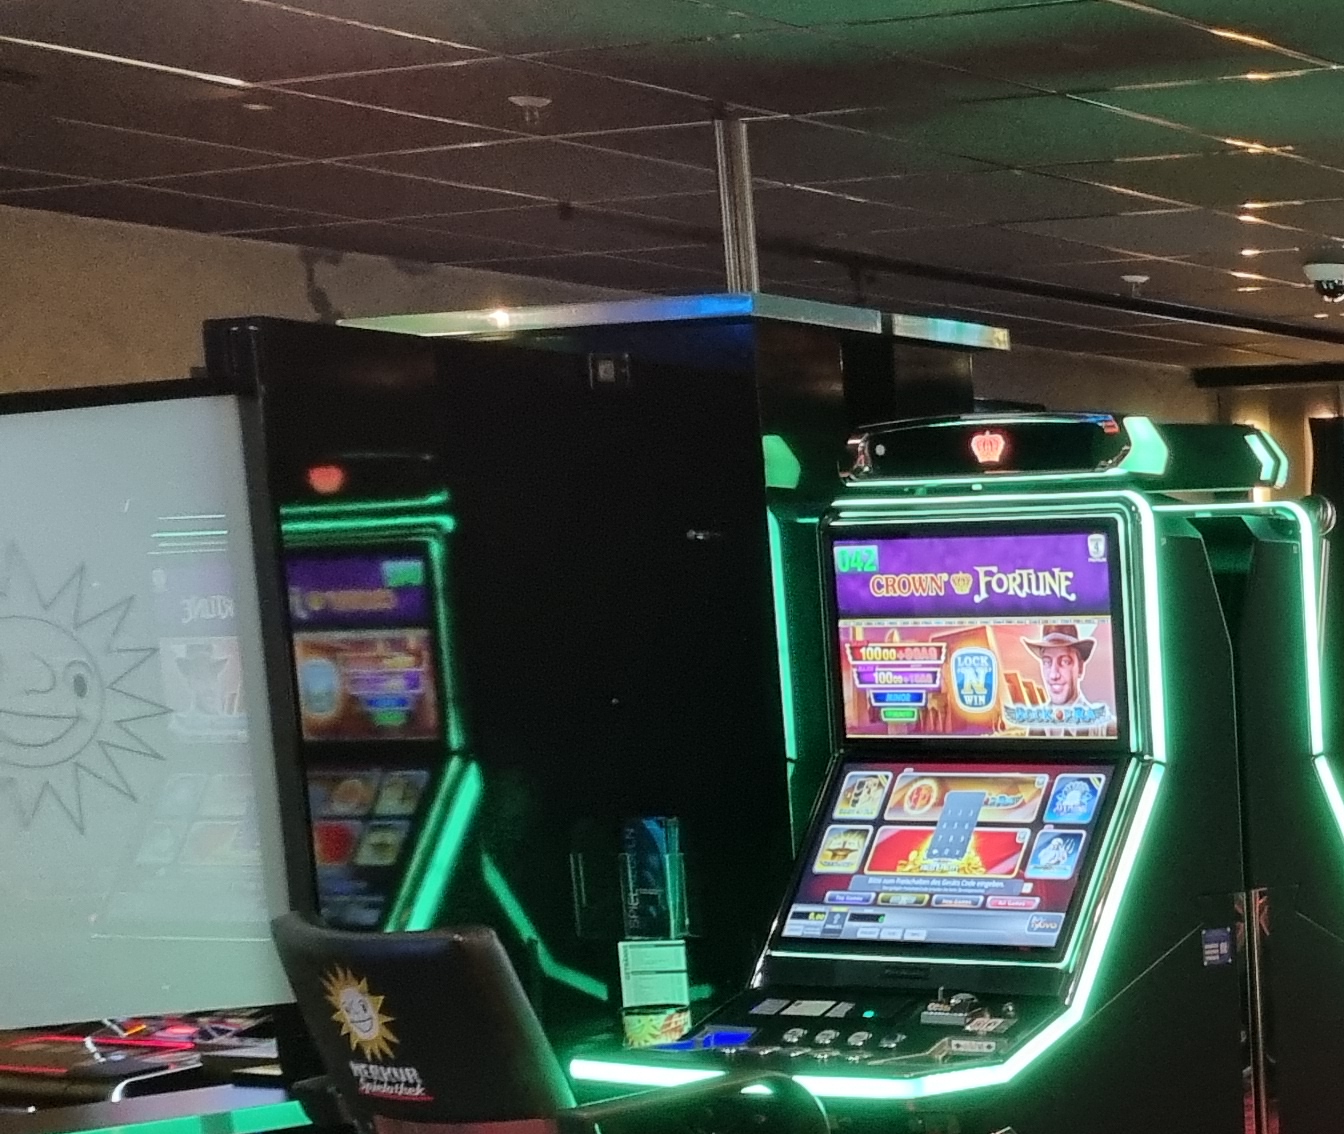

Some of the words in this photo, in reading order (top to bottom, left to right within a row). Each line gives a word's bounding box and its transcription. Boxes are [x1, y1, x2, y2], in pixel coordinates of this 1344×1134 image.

[838, 547, 877, 572] 042
[869, 572, 948, 598] CROWN
[973, 565, 1076, 604] FORTUNE
[957, 656, 989, 667] LOCK
[963, 694, 987, 706] WIN
[349, 1061, 423, 1084] MERKUR
